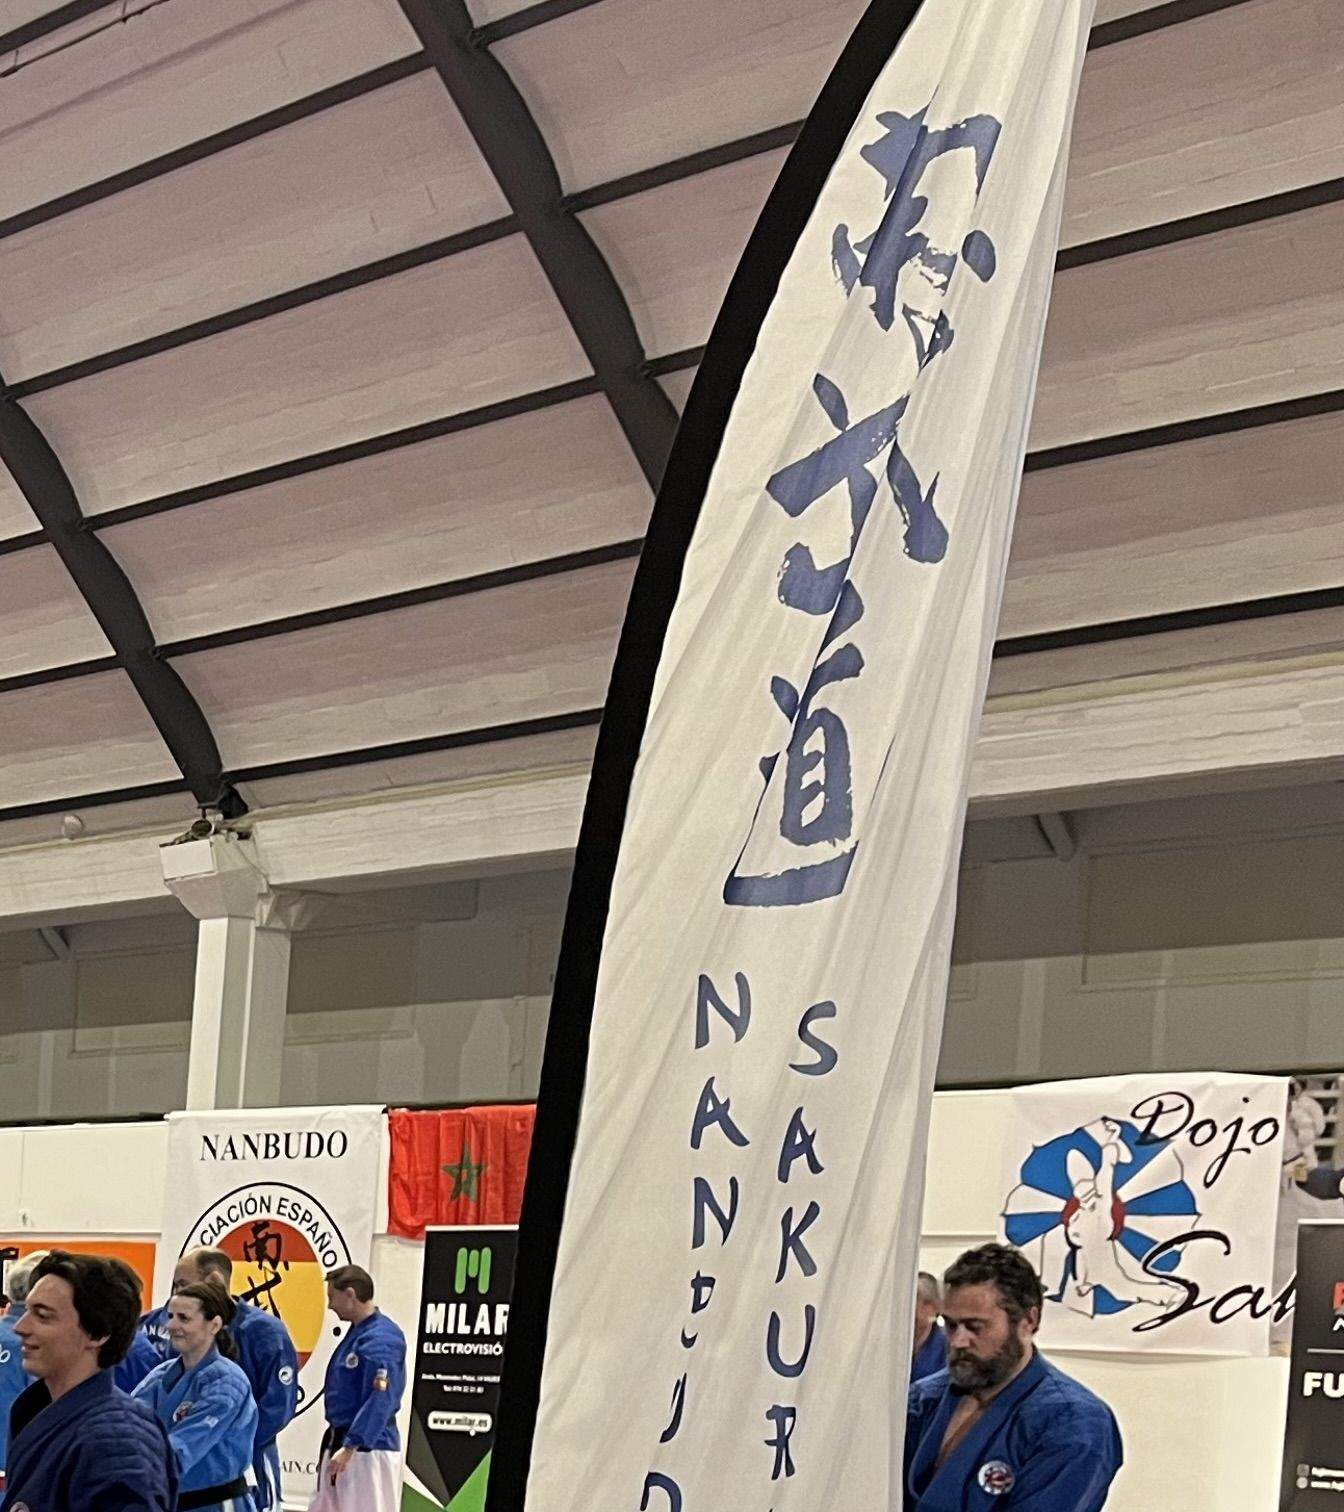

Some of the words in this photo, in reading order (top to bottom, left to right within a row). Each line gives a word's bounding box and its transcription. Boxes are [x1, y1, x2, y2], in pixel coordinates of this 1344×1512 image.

[200, 1130, 348, 1161] NANBUDO
[1130, 1090, 1280, 1189] Dojo
[425, 1303, 510, 1336] MILAR
[431, 1414, 489, 1429] www.milar.es
